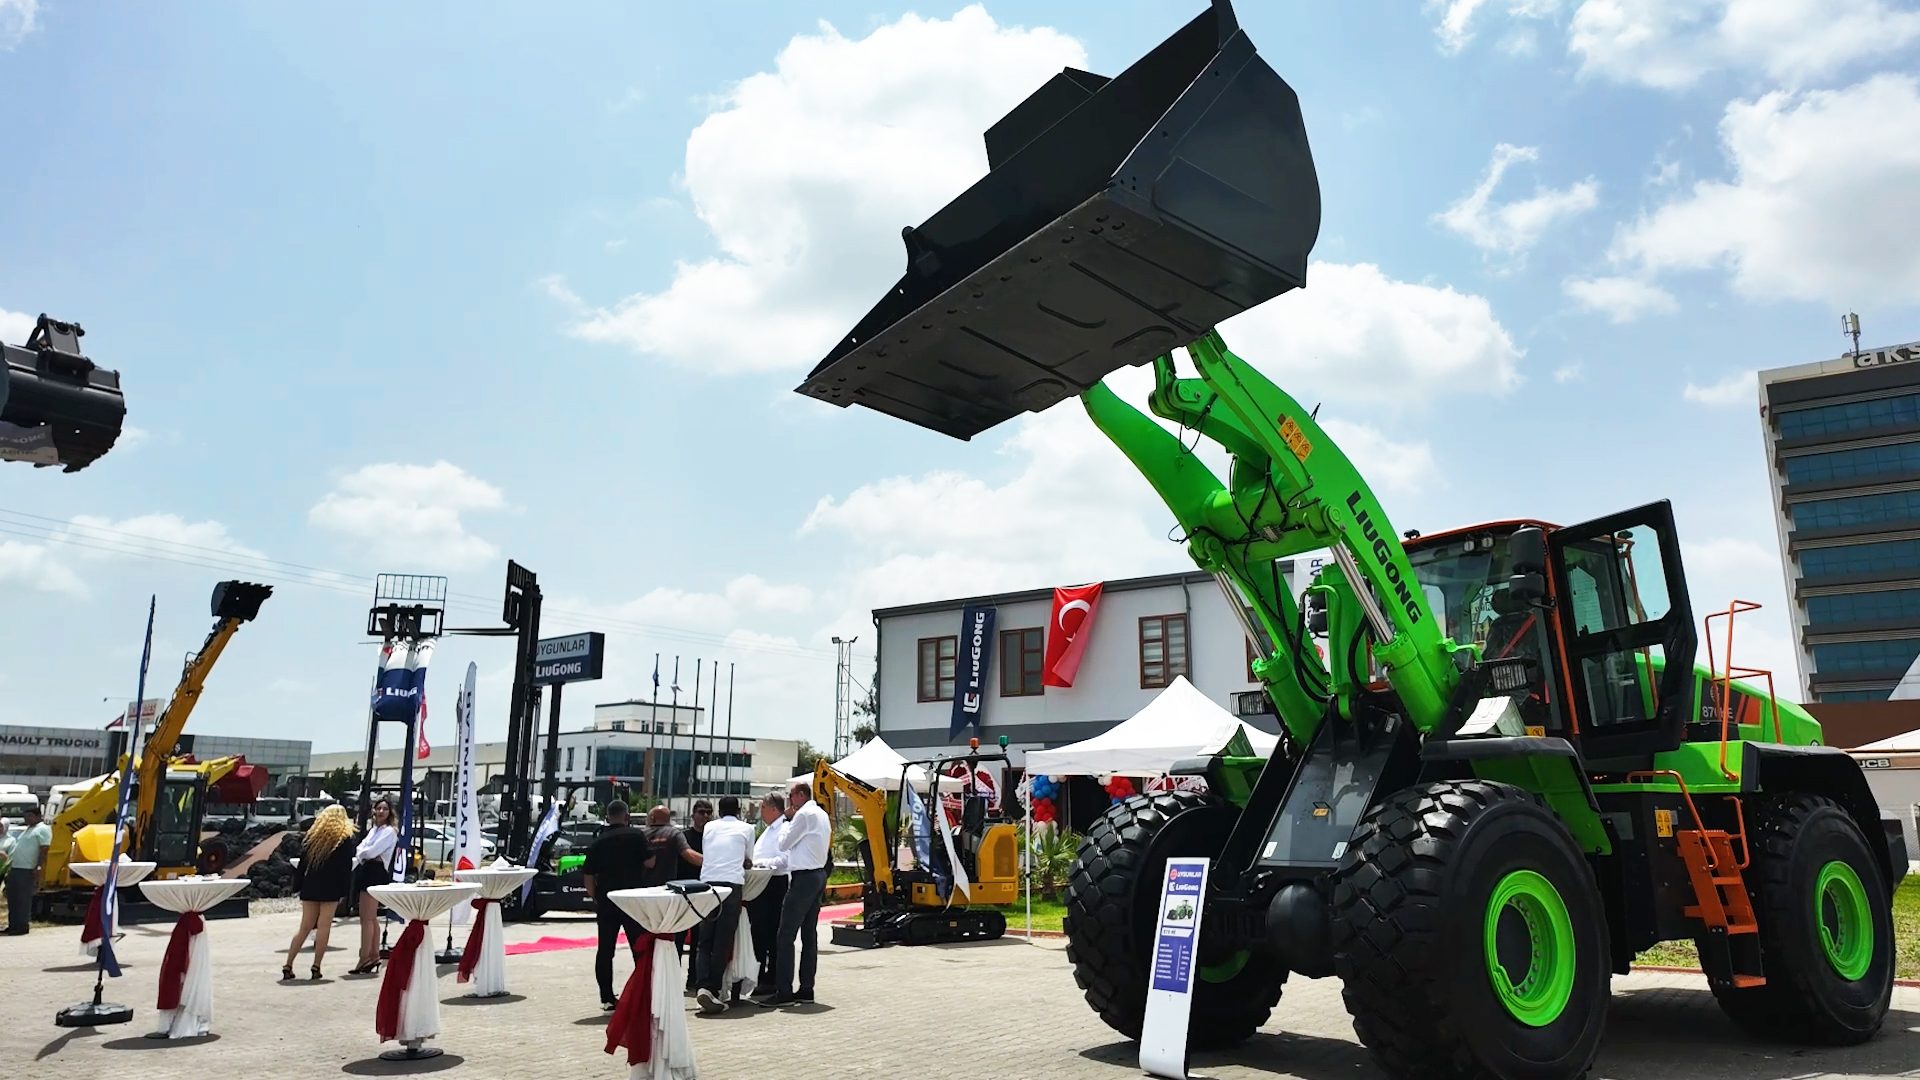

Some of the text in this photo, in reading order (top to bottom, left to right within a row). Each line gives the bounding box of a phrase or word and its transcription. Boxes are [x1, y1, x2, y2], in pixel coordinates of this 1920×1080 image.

[1346, 490, 1422, 624] LIUGONG
[535, 662, 581, 678] LIUGONG
[970, 612, 985, 688] LIUGONG
